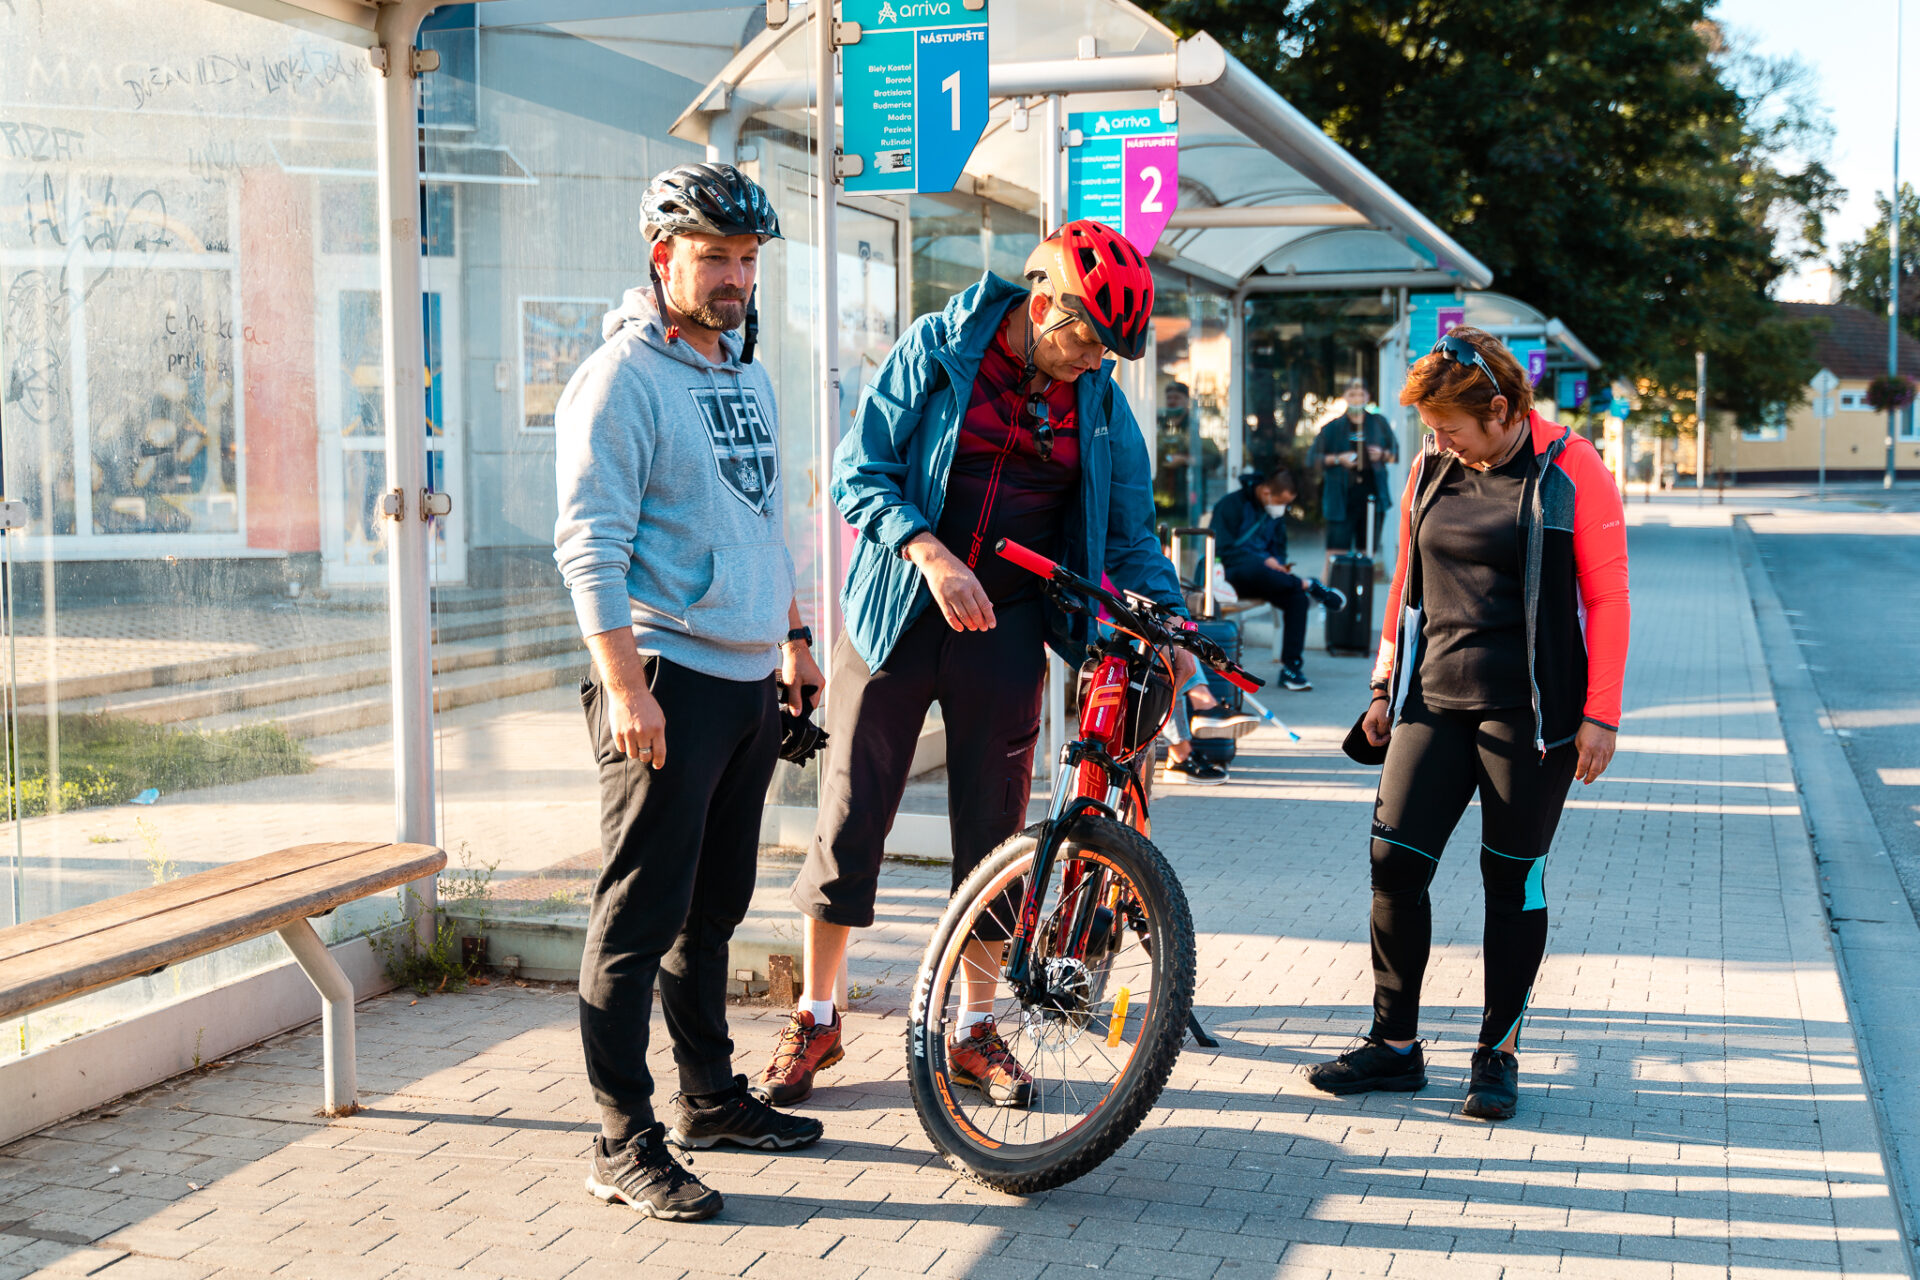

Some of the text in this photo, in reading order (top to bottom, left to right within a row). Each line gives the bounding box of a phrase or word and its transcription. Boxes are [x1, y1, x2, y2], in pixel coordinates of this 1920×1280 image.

[900, 0, 950, 17] arriva
[920, 30, 985, 44] NÁSTUPIŠTE
[874, 89, 912, 97] Bratislava
[941, 70, 961, 131] 1
[873, 101, 912, 110] Budmerice
[883, 126, 912, 134] Pezinok
[1111, 117, 1151, 129] arriva
[1127, 138, 1176, 148] NÁSTUPIŠTE
[1139, 166, 1163, 213] 2
[701, 402, 769, 439] LA
[914, 968, 934, 1058] MAXXIS
[935, 1071, 1003, 1150] CRUSSIS
